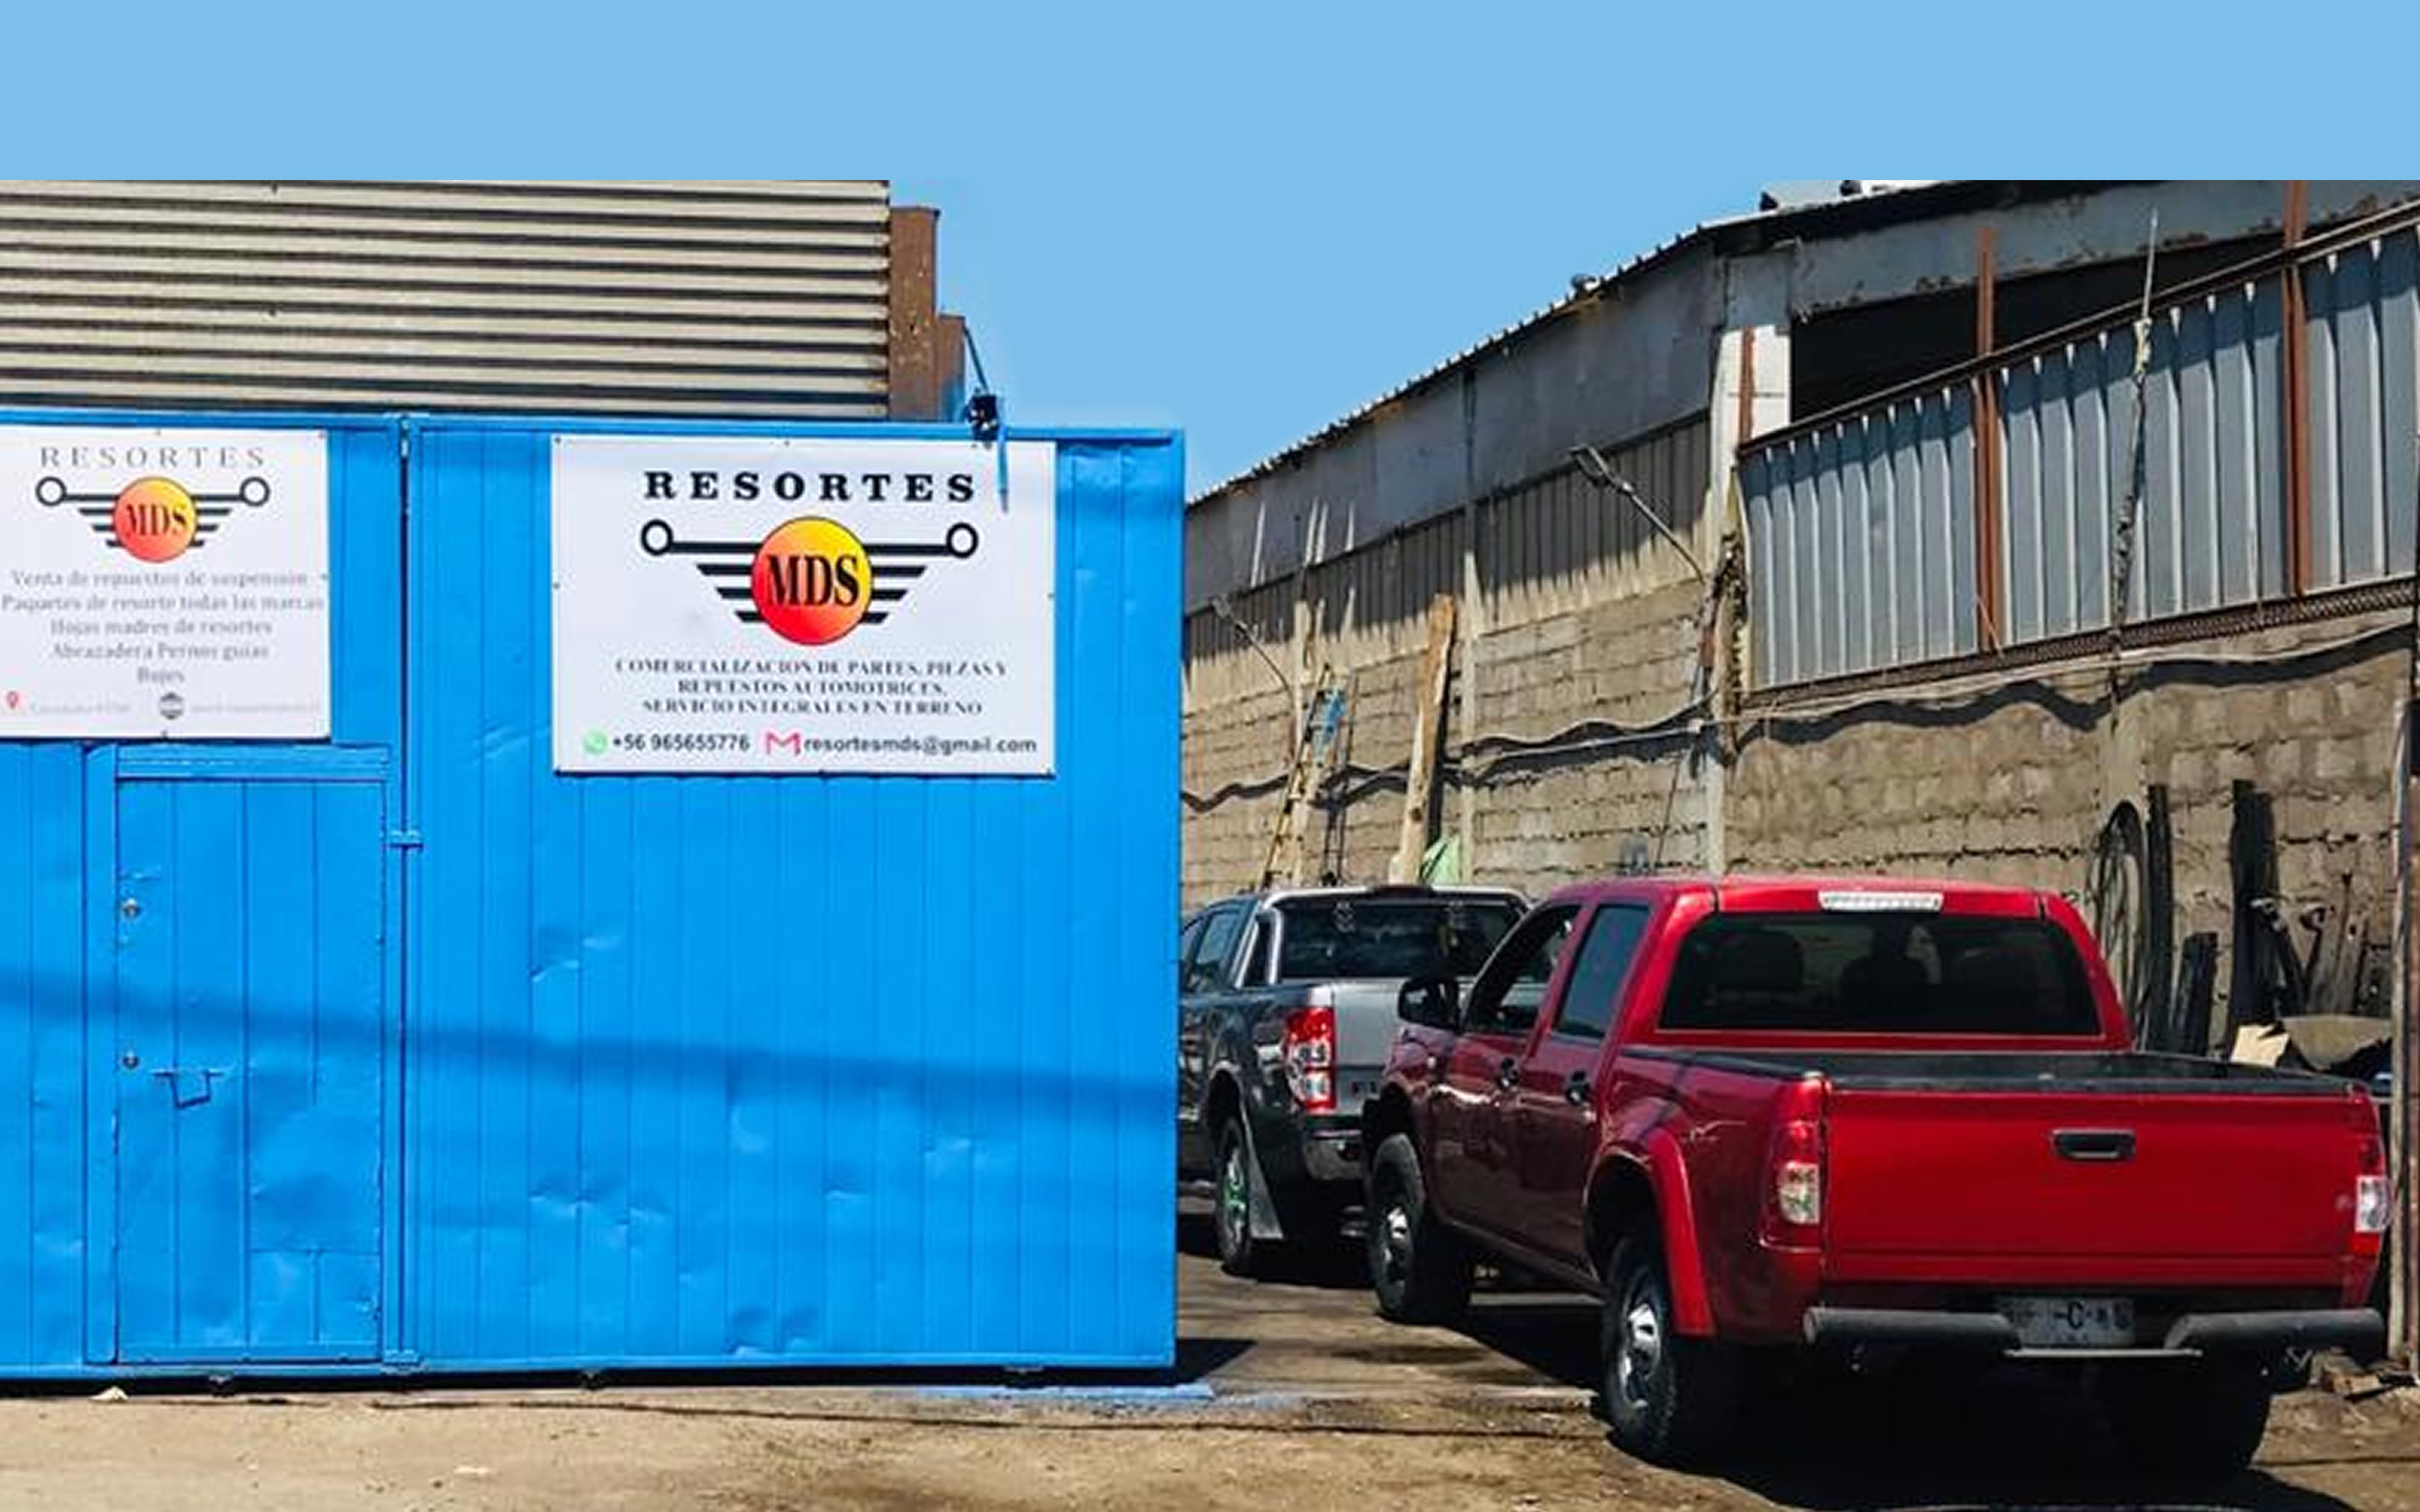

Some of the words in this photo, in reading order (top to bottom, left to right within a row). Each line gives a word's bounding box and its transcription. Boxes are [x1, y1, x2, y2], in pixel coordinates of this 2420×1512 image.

[40, 446, 266, 469] RESORTES
[645, 471, 975, 502] RESORTES
[126, 503, 188, 537] MDS
[11, 569, 62, 586] Venta
[67, 569, 89, 586] de
[94, 573, 179, 589] repuestos
[184, 570, 205, 586] de
[766, 554, 859, 607] MDS
[1, 594, 82, 614] Paquetes
[87, 594, 107, 610] de
[179, 594, 228, 610] todas
[233, 594, 257, 610] las
[261, 598, 324, 610] marcas
[50, 619, 100, 637] Hojas
[105, 620, 169, 635] madres
[174, 619, 195, 634] de
[199, 620, 273, 635] resortes
[52, 642, 153, 659] Abrazadera
[157, 642, 218, 659] Pernos
[137, 666, 186, 686] Bujes
[817, 660, 840, 675] DE
[926, 661, 993, 676] PIEZAS
[677, 679, 788, 694] REPUESTOS
[642, 698, 735, 713] SERVICIO
[738, 699, 859, 714] INTEGRALES
[862, 700, 888, 714] EN
[893, 700, 983, 715] TERRENO
[613, 733, 645, 752] +56
[650, 733, 751, 753] 965655776
[803, 736, 1037, 756] resortesmds@gmail.com
